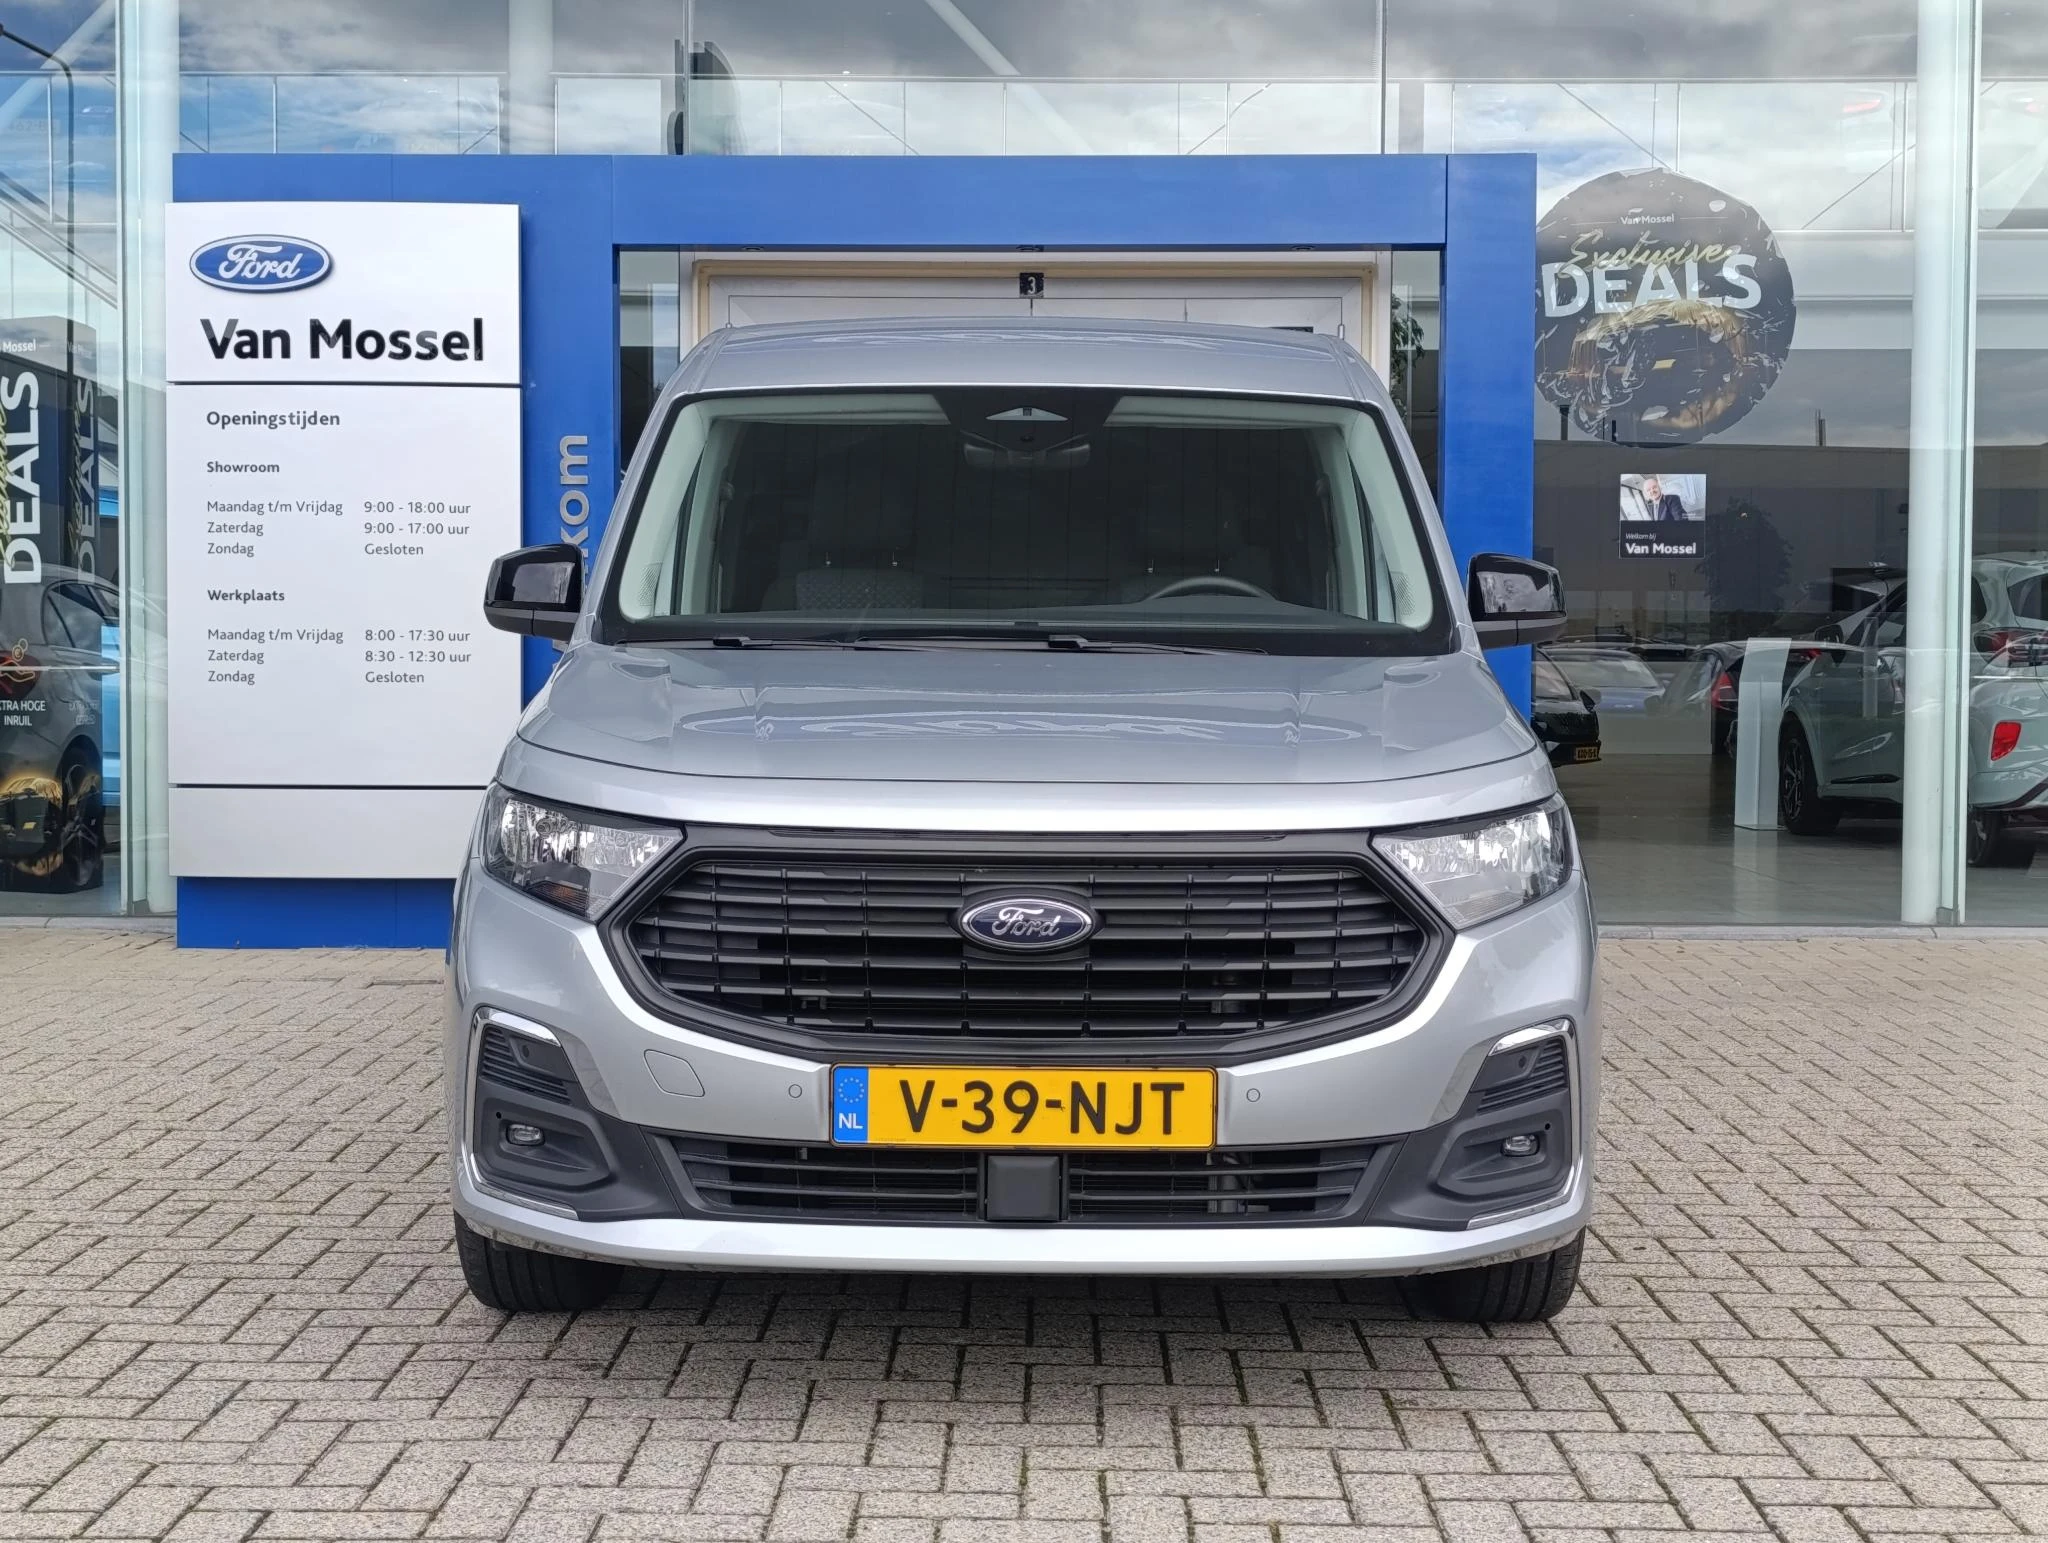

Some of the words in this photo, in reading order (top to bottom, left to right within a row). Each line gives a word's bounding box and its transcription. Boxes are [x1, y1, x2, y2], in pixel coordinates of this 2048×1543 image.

[1621, 216, 1639, 226] Van
[1641, 213, 1675, 224] Mossel
[218, 243, 304, 280] Ford
[1028, 276, 1036, 294] 3
[1541, 253, 1762, 318] DEALS
[3, 338, 37, 353] Mossel
[199, 318, 291, 360] Van
[309, 317, 484, 362] Mossel
[206, 410, 341, 430] Openingstijden
[206, 460, 281, 474] Showroom
[2, 371, 42, 584] DEALS
[206, 500, 266, 517] Maandag
[267, 500, 293, 514] t/m
[295, 500, 344, 517] Vrijdag
[363, 500, 395, 514] 9:00
[407, 501, 446, 514] 18:00
[448, 504, 472, 514] uur
[206, 521, 265, 537] Zaterdag
[363, 522, 395, 535] 9:00
[407, 522, 445, 535] 17:00
[447, 525, 471, 535] uur
[206, 541, 256, 558] Zondag
[363, 542, 425, 557] Gesloten
[1625, 542, 1649, 555] Van
[1652, 542, 1697, 555] Mossel
[206, 588, 286, 606] Werkplaats
[207, 628, 267, 645] Maandag
[268, 628, 294, 642] t/m
[296, 628, 345, 645] Vrijdag
[364, 629, 396, 642] 8:00
[408, 629, 445, 642] 17:30
[448, 632, 472, 642] uur
[207, 648, 265, 665] Zaterdag
[364, 650, 396, 663] 8:30
[408, 650, 446, 663] 12:30
[449, 653, 472, 663] uur
[207, 670, 257, 686] Zondag
[364, 671, 425, 684] Gesloten
[0, 700, 19, 711] TRA
[21, 700, 46, 711] HOGE
[4, 715, 32, 726] INRUIL
[991, 906, 1061, 937] Ford
[898, 1078, 1186, 1136] V-39-NJT
[838, 1112, 863, 1130] NL
